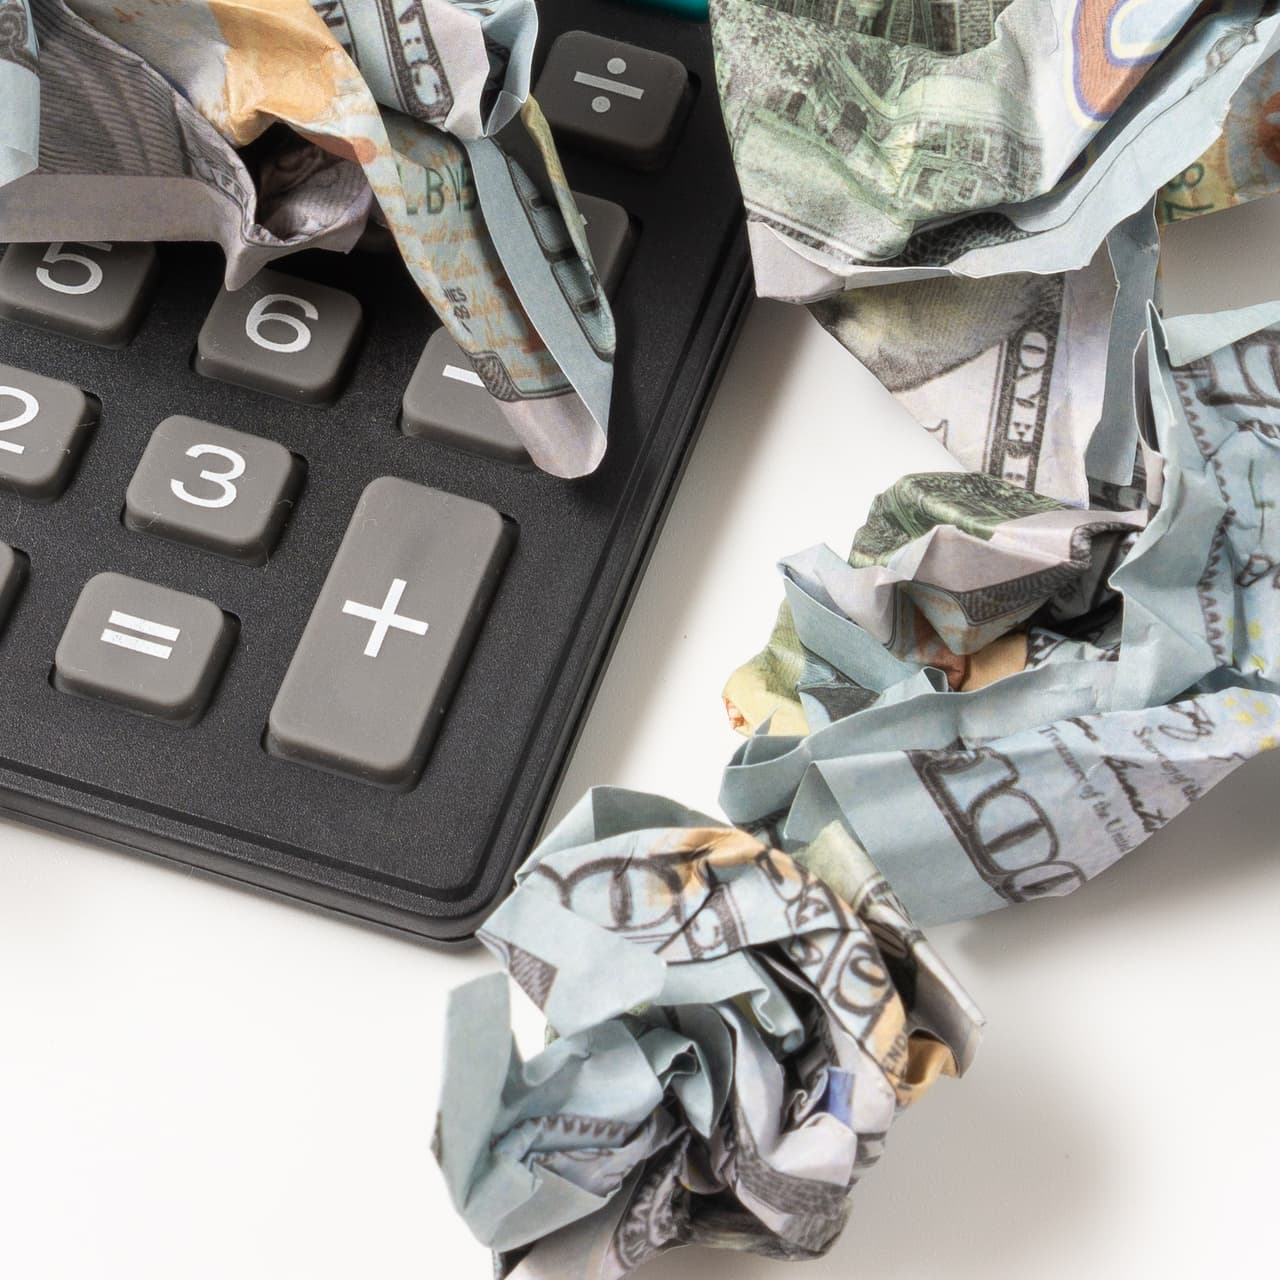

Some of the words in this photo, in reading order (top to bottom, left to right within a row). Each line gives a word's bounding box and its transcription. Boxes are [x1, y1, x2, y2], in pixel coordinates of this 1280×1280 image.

[34, 240, 113, 296] 5
[245, 292, 320, 355] 6
[169, 442, 246, 510] 3
